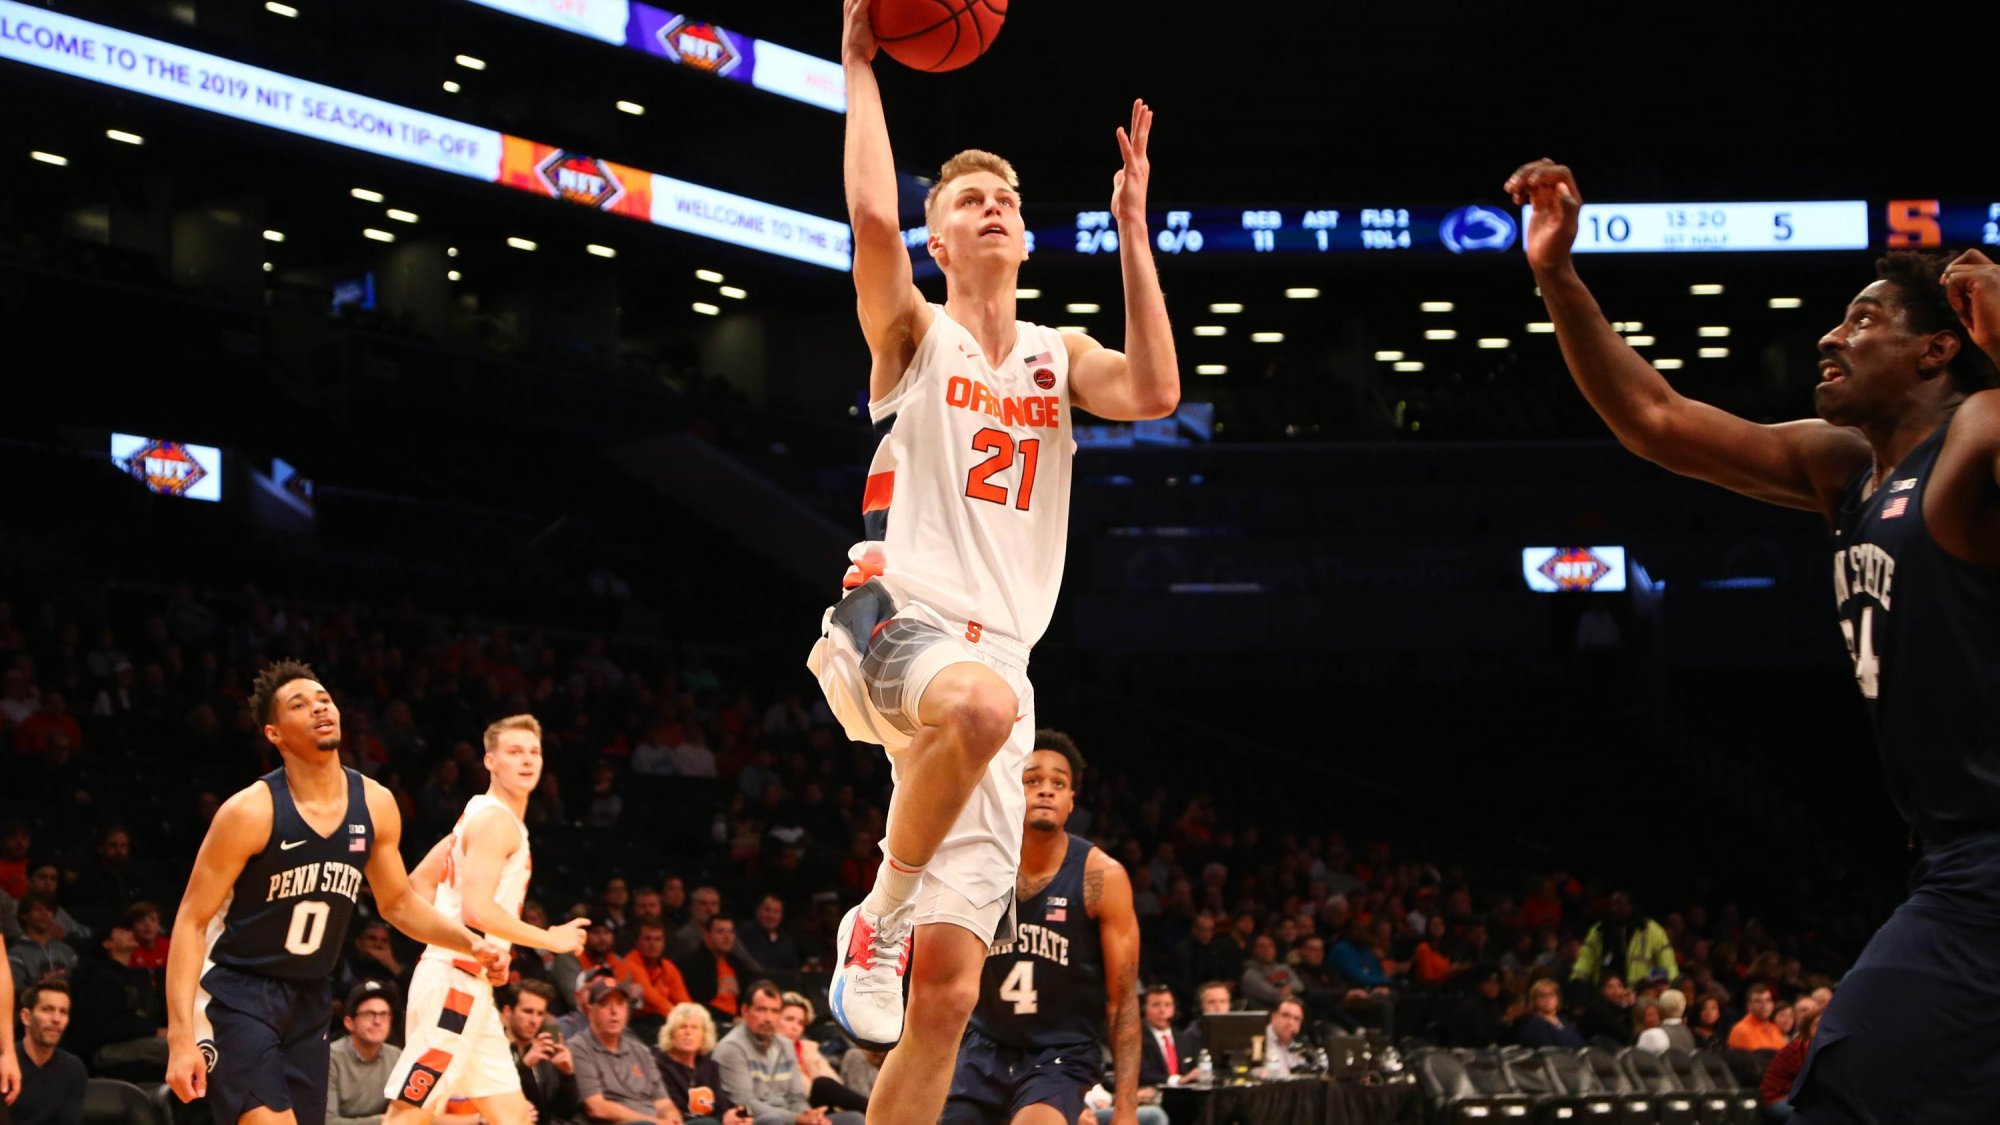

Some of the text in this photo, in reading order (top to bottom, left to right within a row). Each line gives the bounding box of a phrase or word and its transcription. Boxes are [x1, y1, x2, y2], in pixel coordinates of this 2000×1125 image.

[0, 16, 479, 159] LCOME TO THE 2019 NIT SEASON TIP-OFF
[673, 194, 765, 233] WELCOME
[771, 218, 793, 240] TO
[798, 225, 827, 249] THE
[1157, 228, 1203, 254] 0/0
[1252, 229, 1274, 252] 11
[1316, 229, 1328, 251] 1
[1302, 210, 1339, 230] AST
[1589, 214, 1630, 243] 10
[1774, 212, 1793, 241] 5
[1888, 199, 1940, 248] S
[965, 427, 1040, 511] 21
[1553, 561, 1597, 580] NIT
[1849, 542, 1896, 611] STATE
[965, 620, 983, 643] S
[266, 861, 363, 904] PENN STATE
[284, 900, 331, 956] 0
[1018, 923, 1069, 966] STATE
[1000, 960, 1038, 1015] 4
[404, 1069, 435, 1101] S
